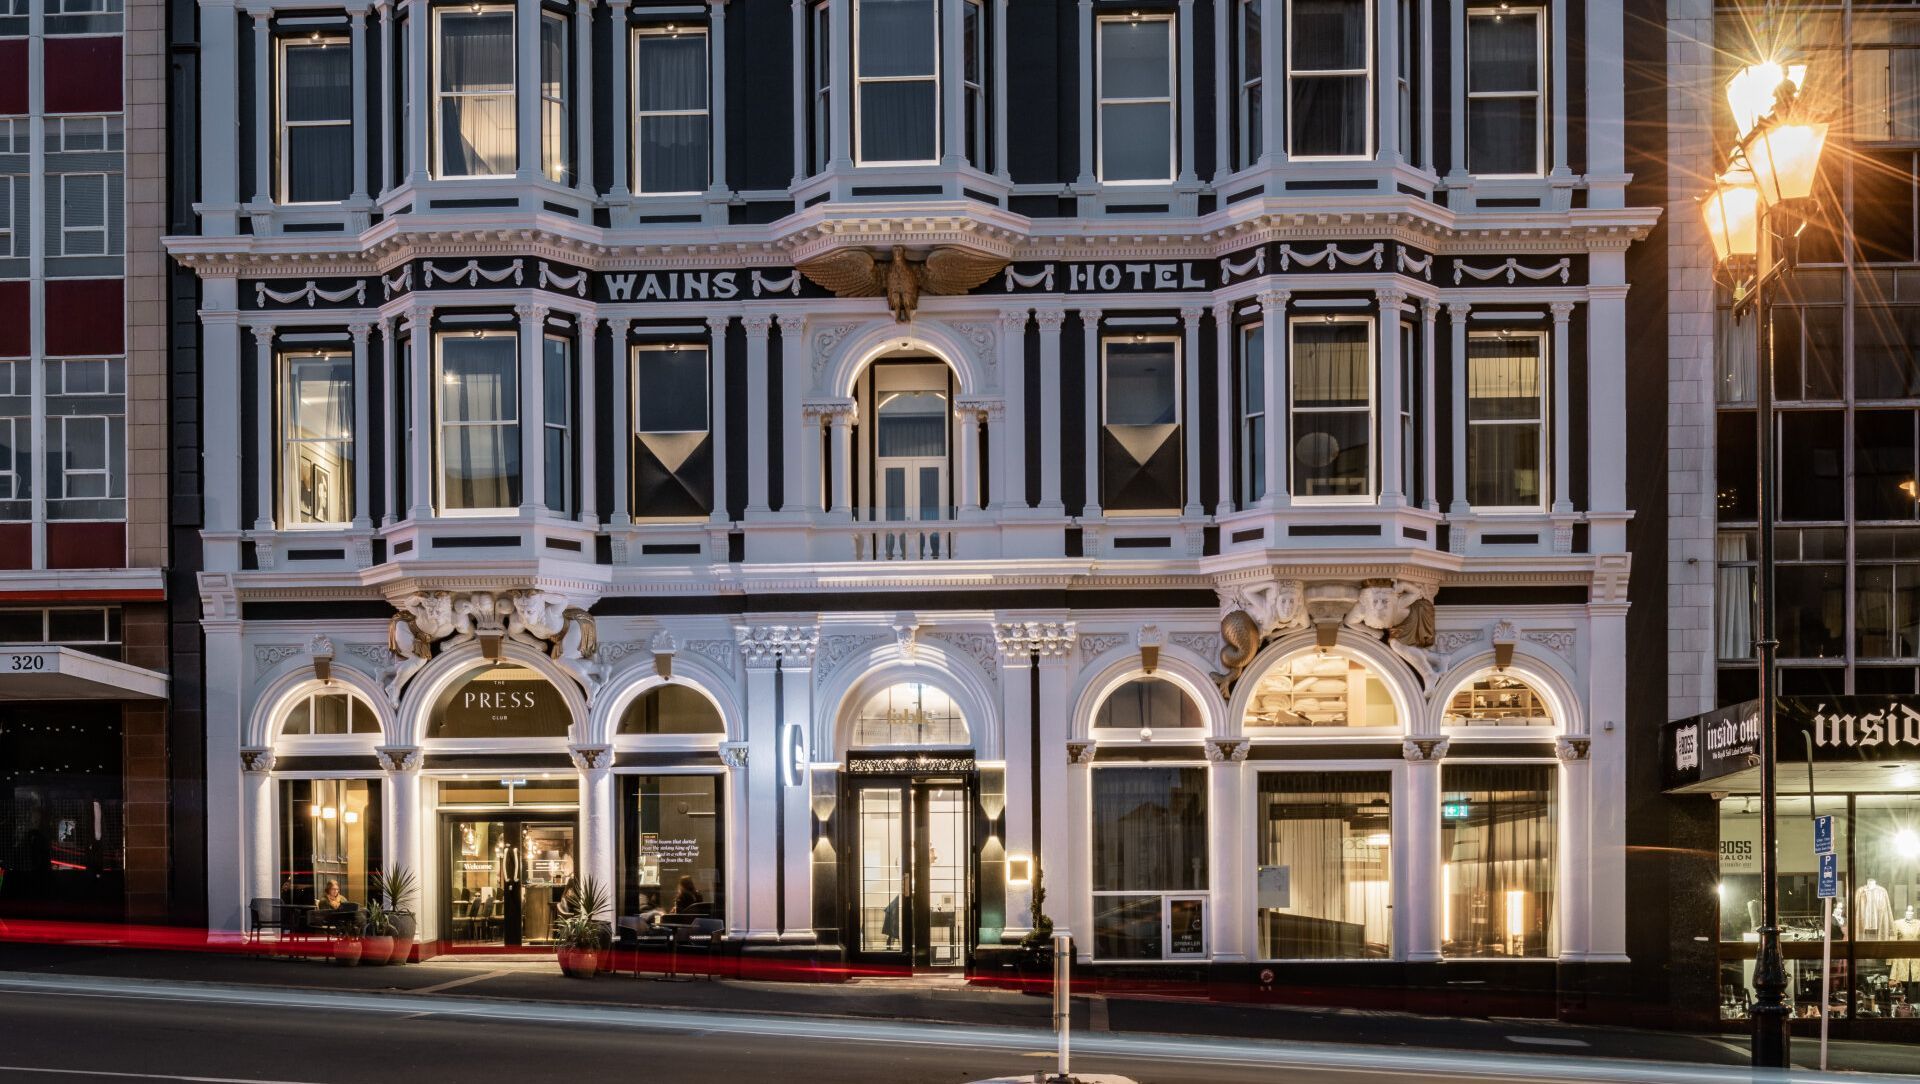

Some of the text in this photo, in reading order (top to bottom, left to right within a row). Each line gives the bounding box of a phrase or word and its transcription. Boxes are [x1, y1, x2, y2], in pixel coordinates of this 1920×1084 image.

[604, 262, 1206, 300] WAINS HOTEL
[12, 655, 44, 670] 320
[465, 691, 535, 709] PRESS
[1707, 712, 1759, 750] inside out
[1820, 818, 1826, 828] P
[1720, 841, 1751, 853] BOSS
[1825, 856, 1831, 865] P
